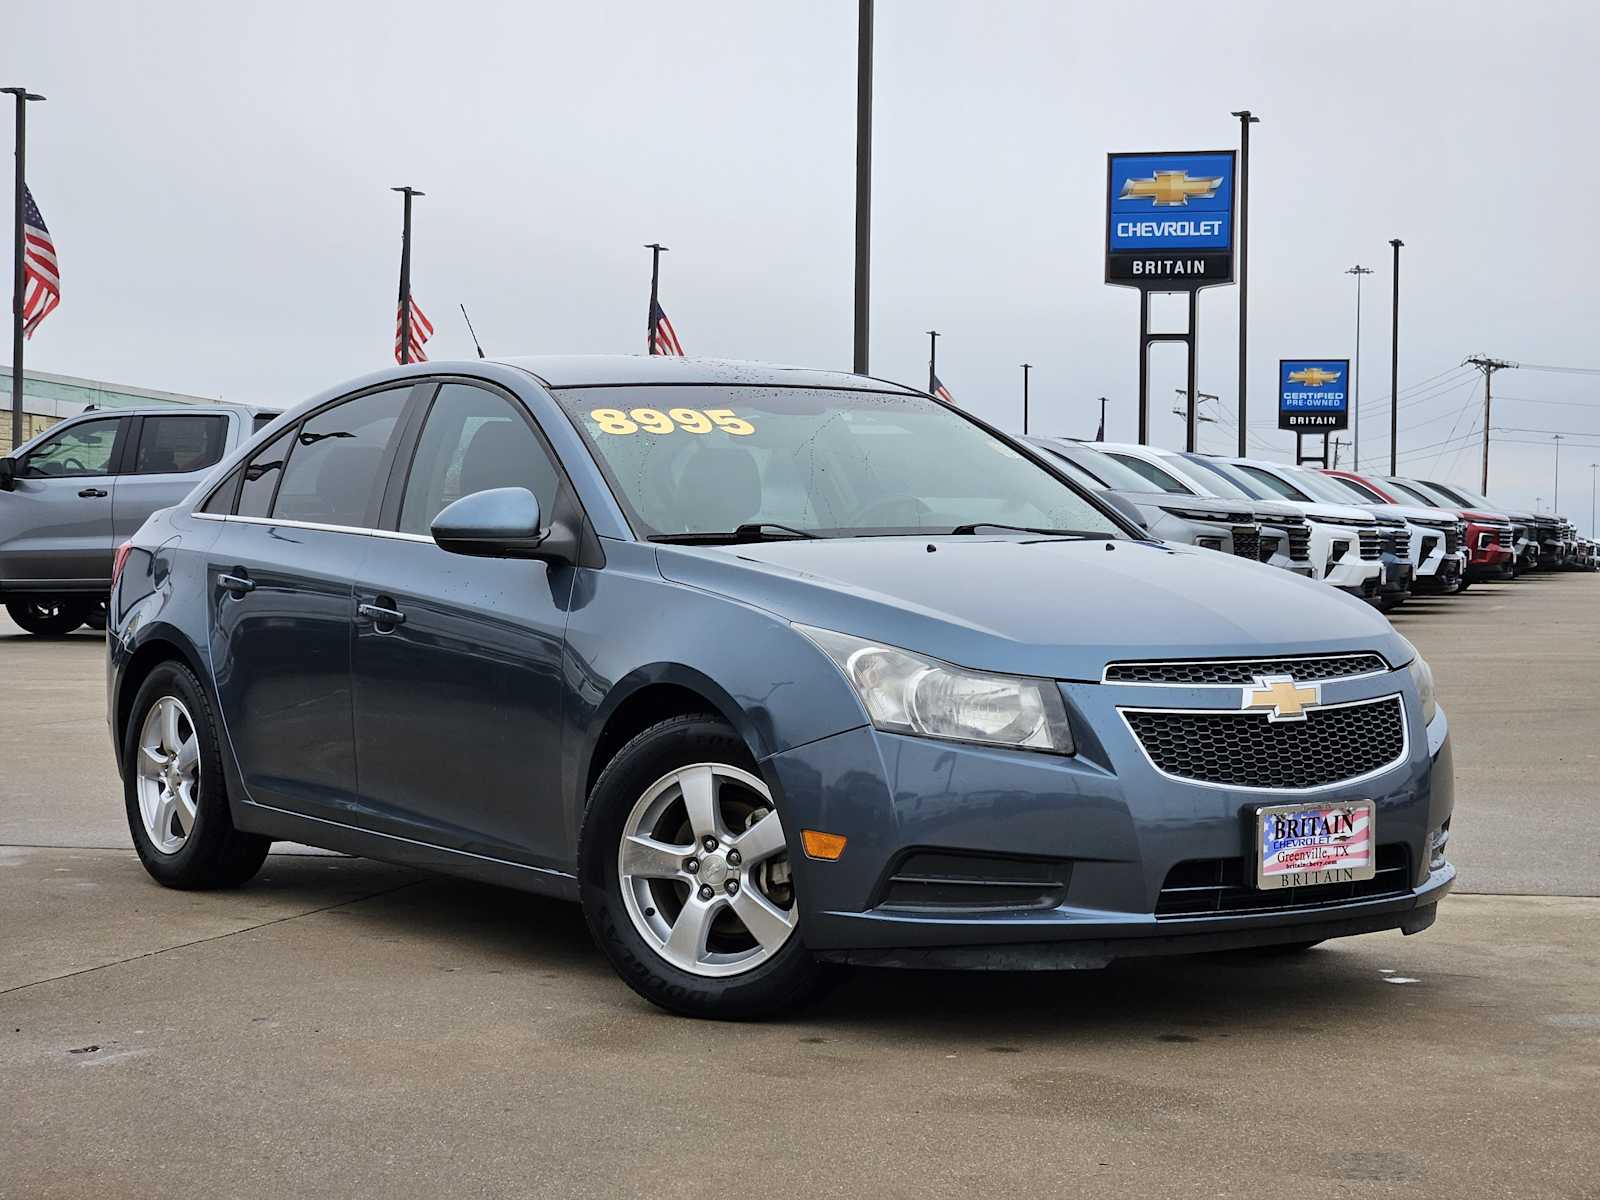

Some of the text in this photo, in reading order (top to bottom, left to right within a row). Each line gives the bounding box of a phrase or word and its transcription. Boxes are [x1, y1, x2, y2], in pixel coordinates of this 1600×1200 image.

[1117, 220, 1222, 237] CHEVROLET
[1132, 260, 1205, 275] BRITAIN
[1283, 392, 1344, 400] CERTIFIED
[590, 408, 756, 436] 8995
[1289, 416, 1336, 425] BRITAIN
[1274, 814, 1354, 840] BRITAIN
[1273, 836, 1331, 850] CHEVROLET
[1277, 846, 1350, 863] Greenville, TX
[1281, 868, 1354, 887] BRITAIN
